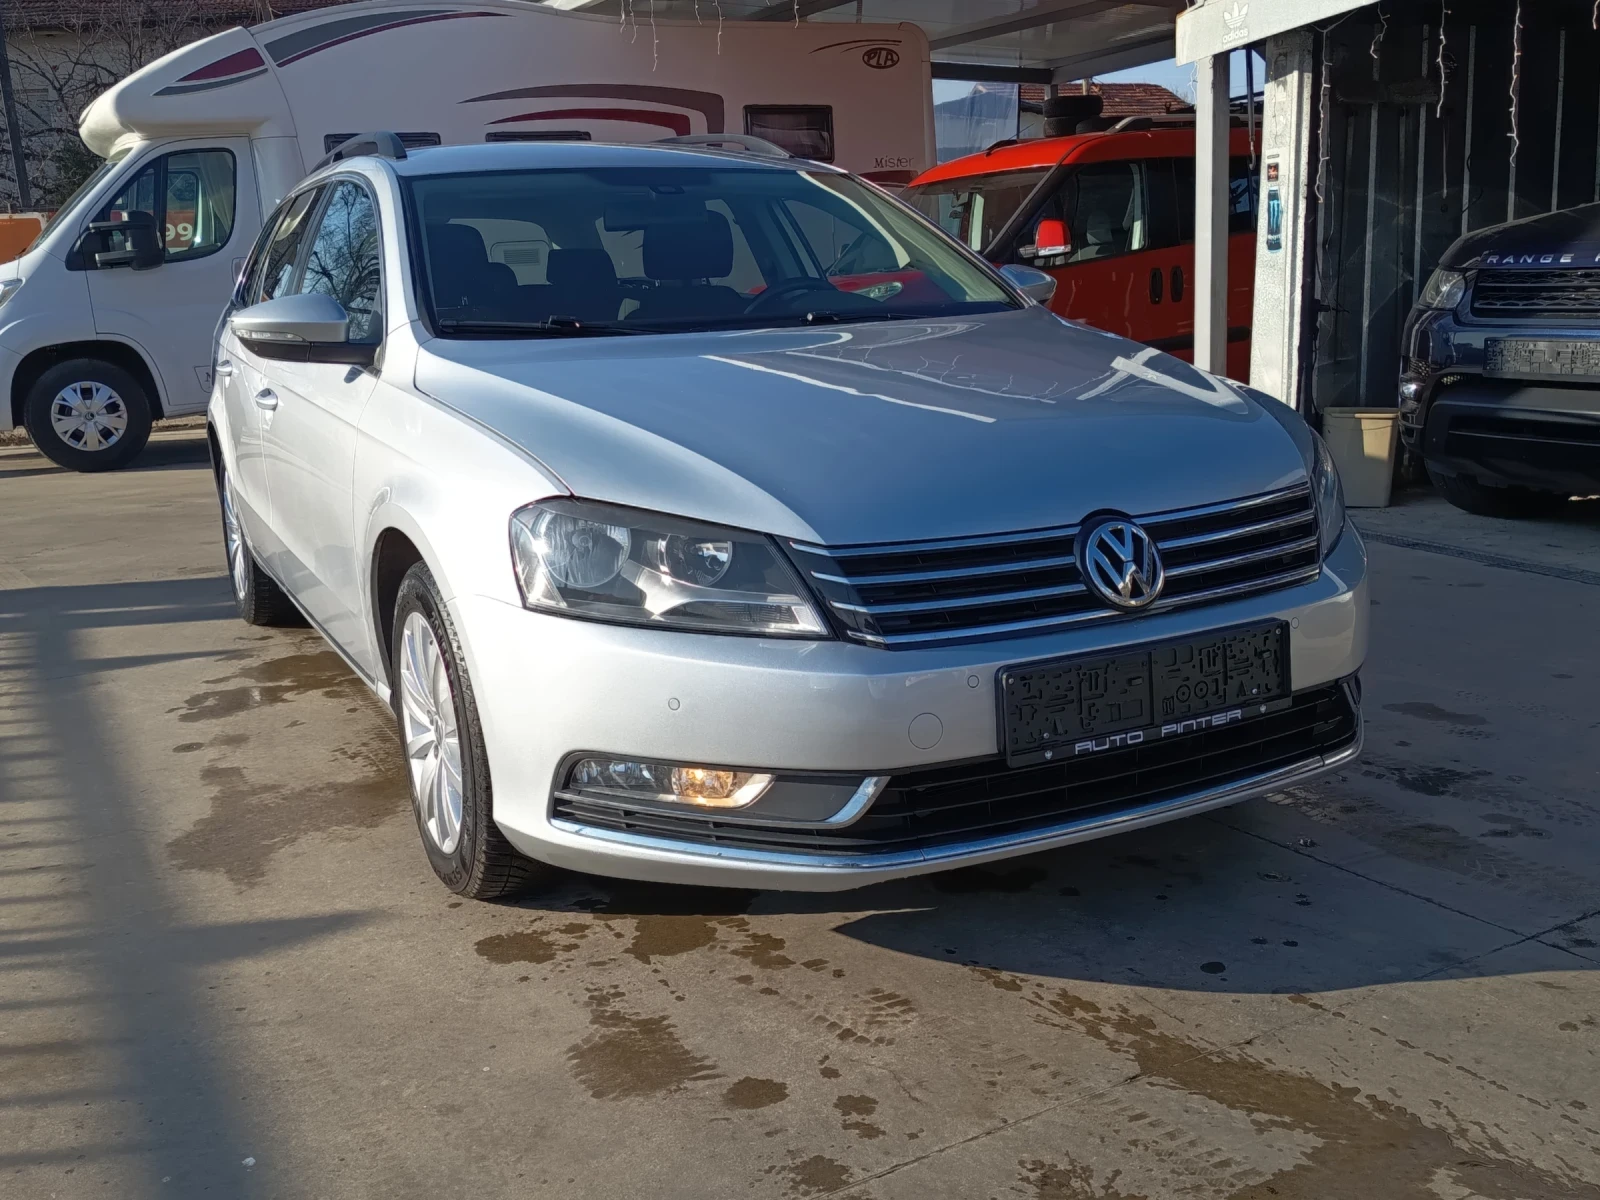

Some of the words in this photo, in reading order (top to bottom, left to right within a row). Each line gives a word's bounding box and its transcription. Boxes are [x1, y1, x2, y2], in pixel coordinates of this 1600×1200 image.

[1222, 28, 1249, 43] adidas
[864, 49, 896, 66] PLA
[873, 155, 914, 168] Mister
[1486, 253, 1575, 264] RANGE
[1075, 730, 1144, 755] AUTO
[1161, 709, 1242, 738] PINTER
